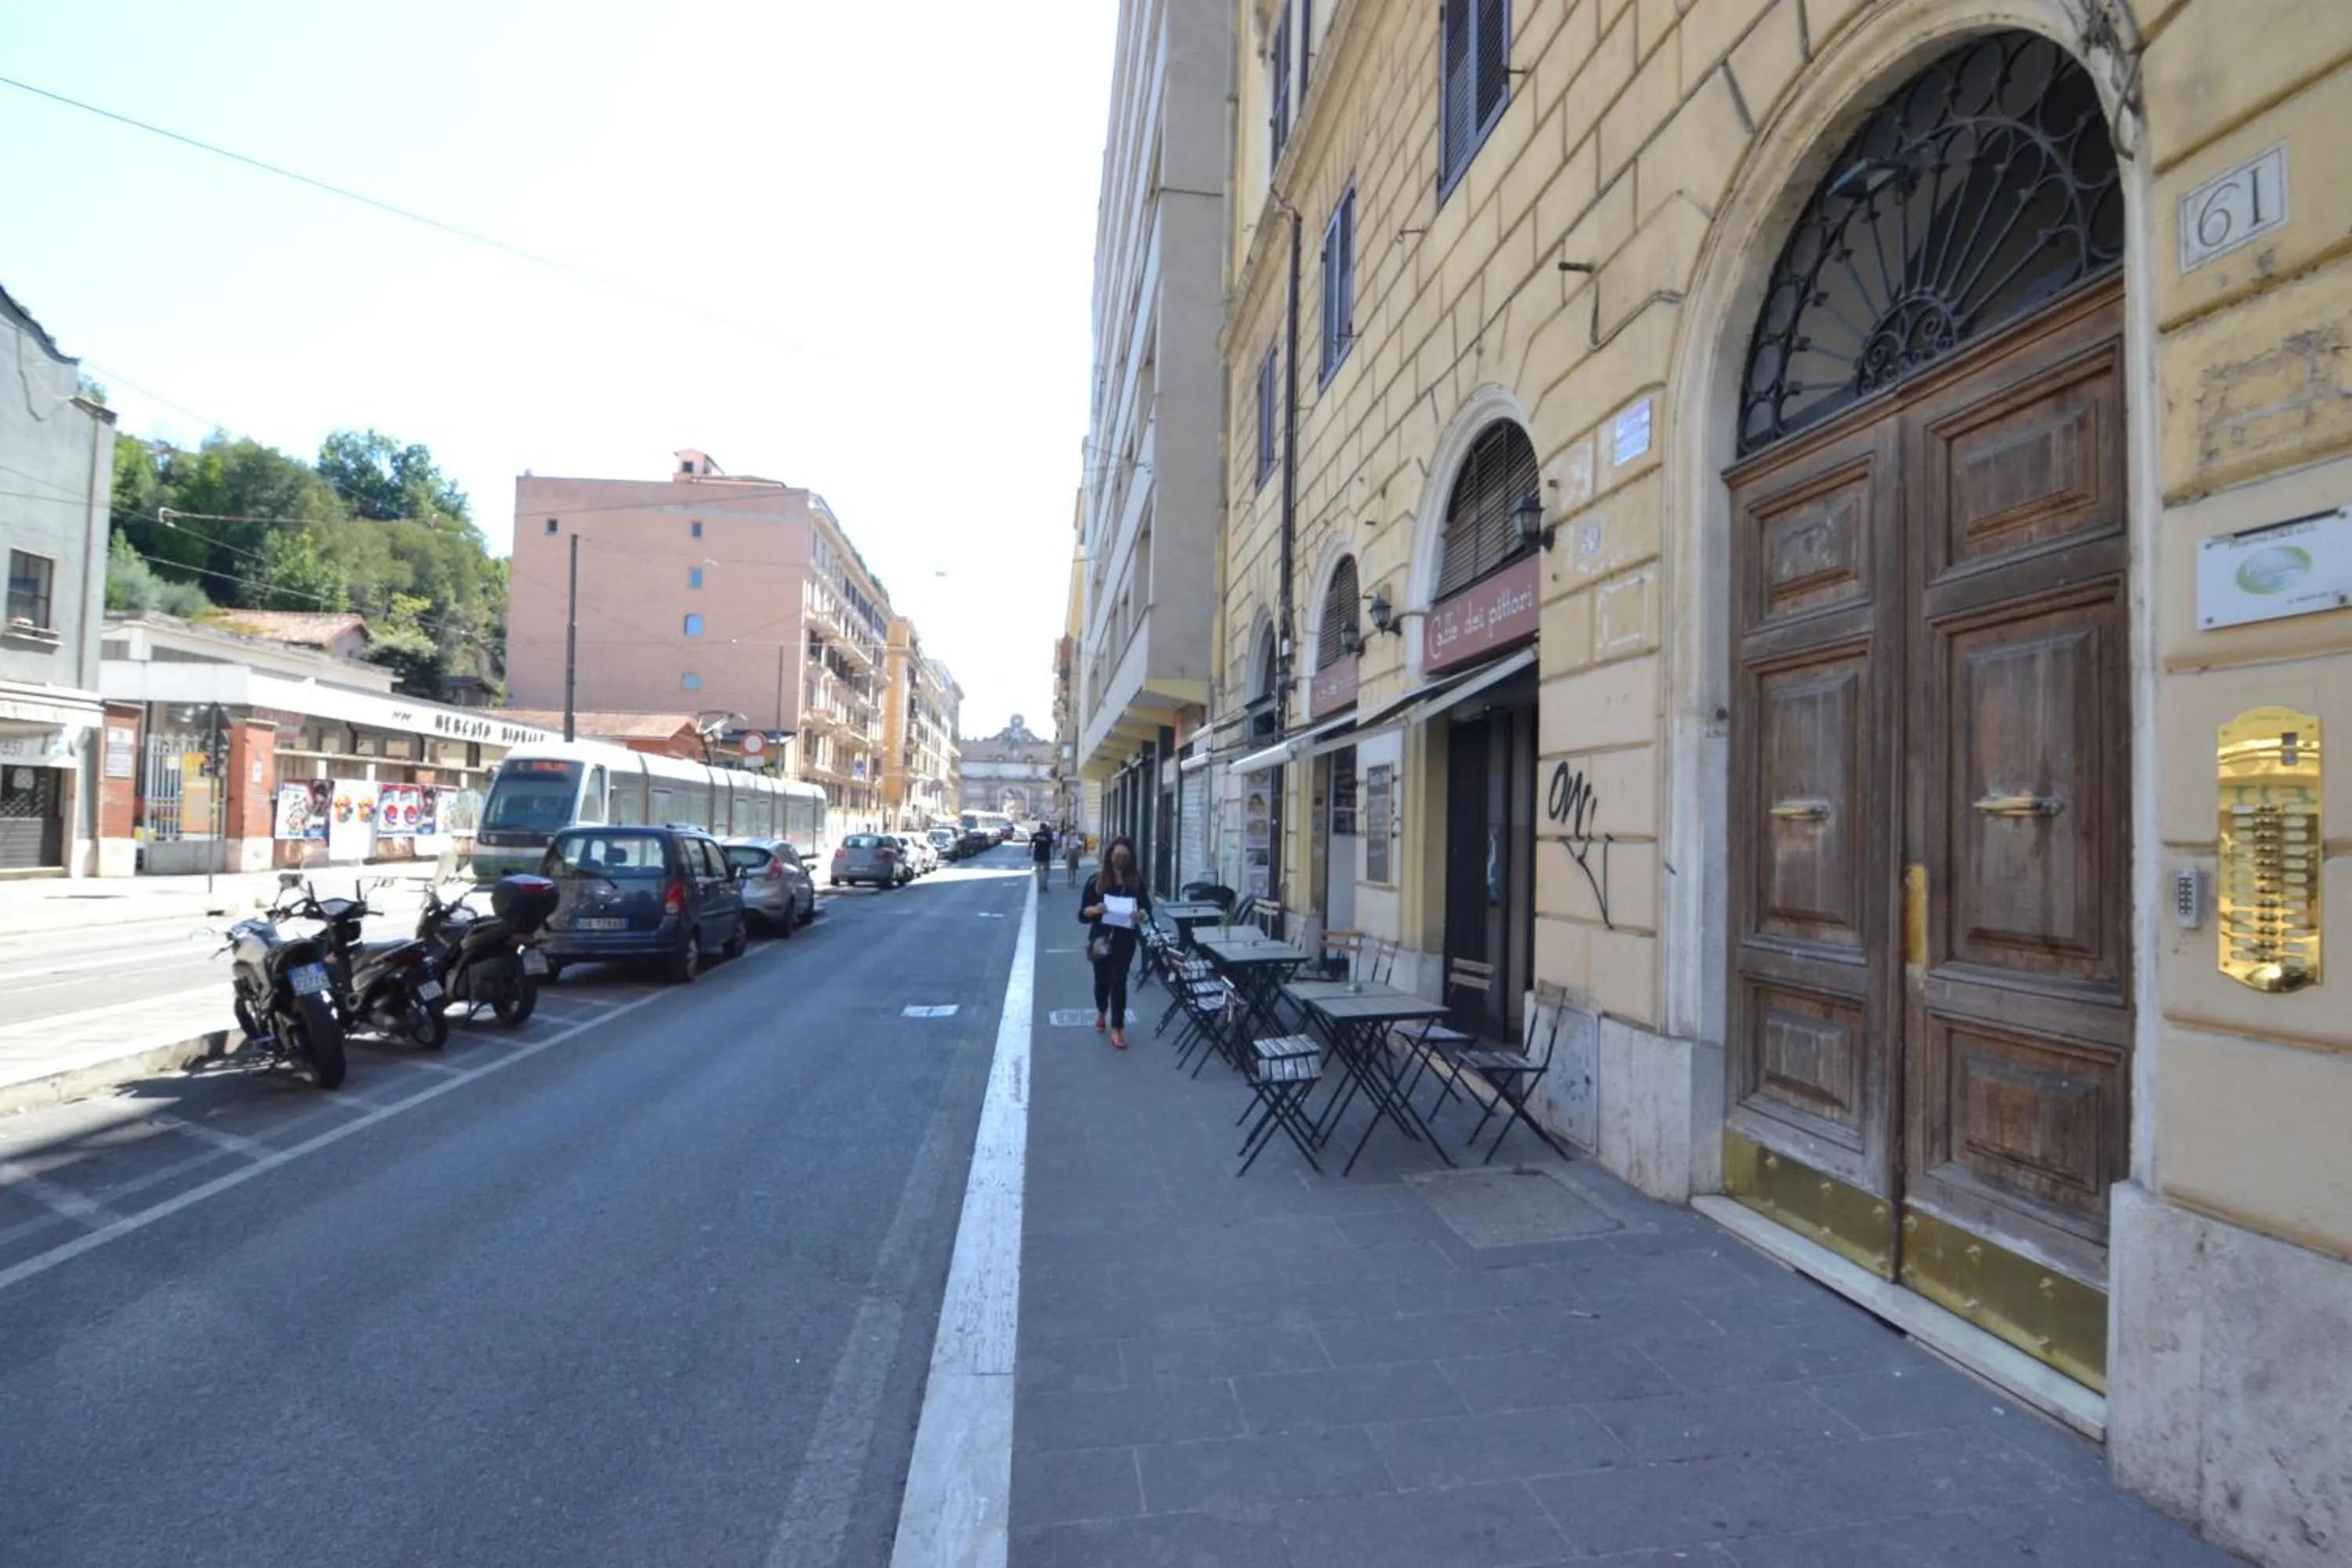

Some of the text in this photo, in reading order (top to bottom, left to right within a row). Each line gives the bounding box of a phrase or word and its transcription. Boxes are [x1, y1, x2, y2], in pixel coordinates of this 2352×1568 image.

[2198, 167, 2266, 248] 61
[1488, 583, 1533, 641] pittori
[435, 714, 492, 740] MERCATO
